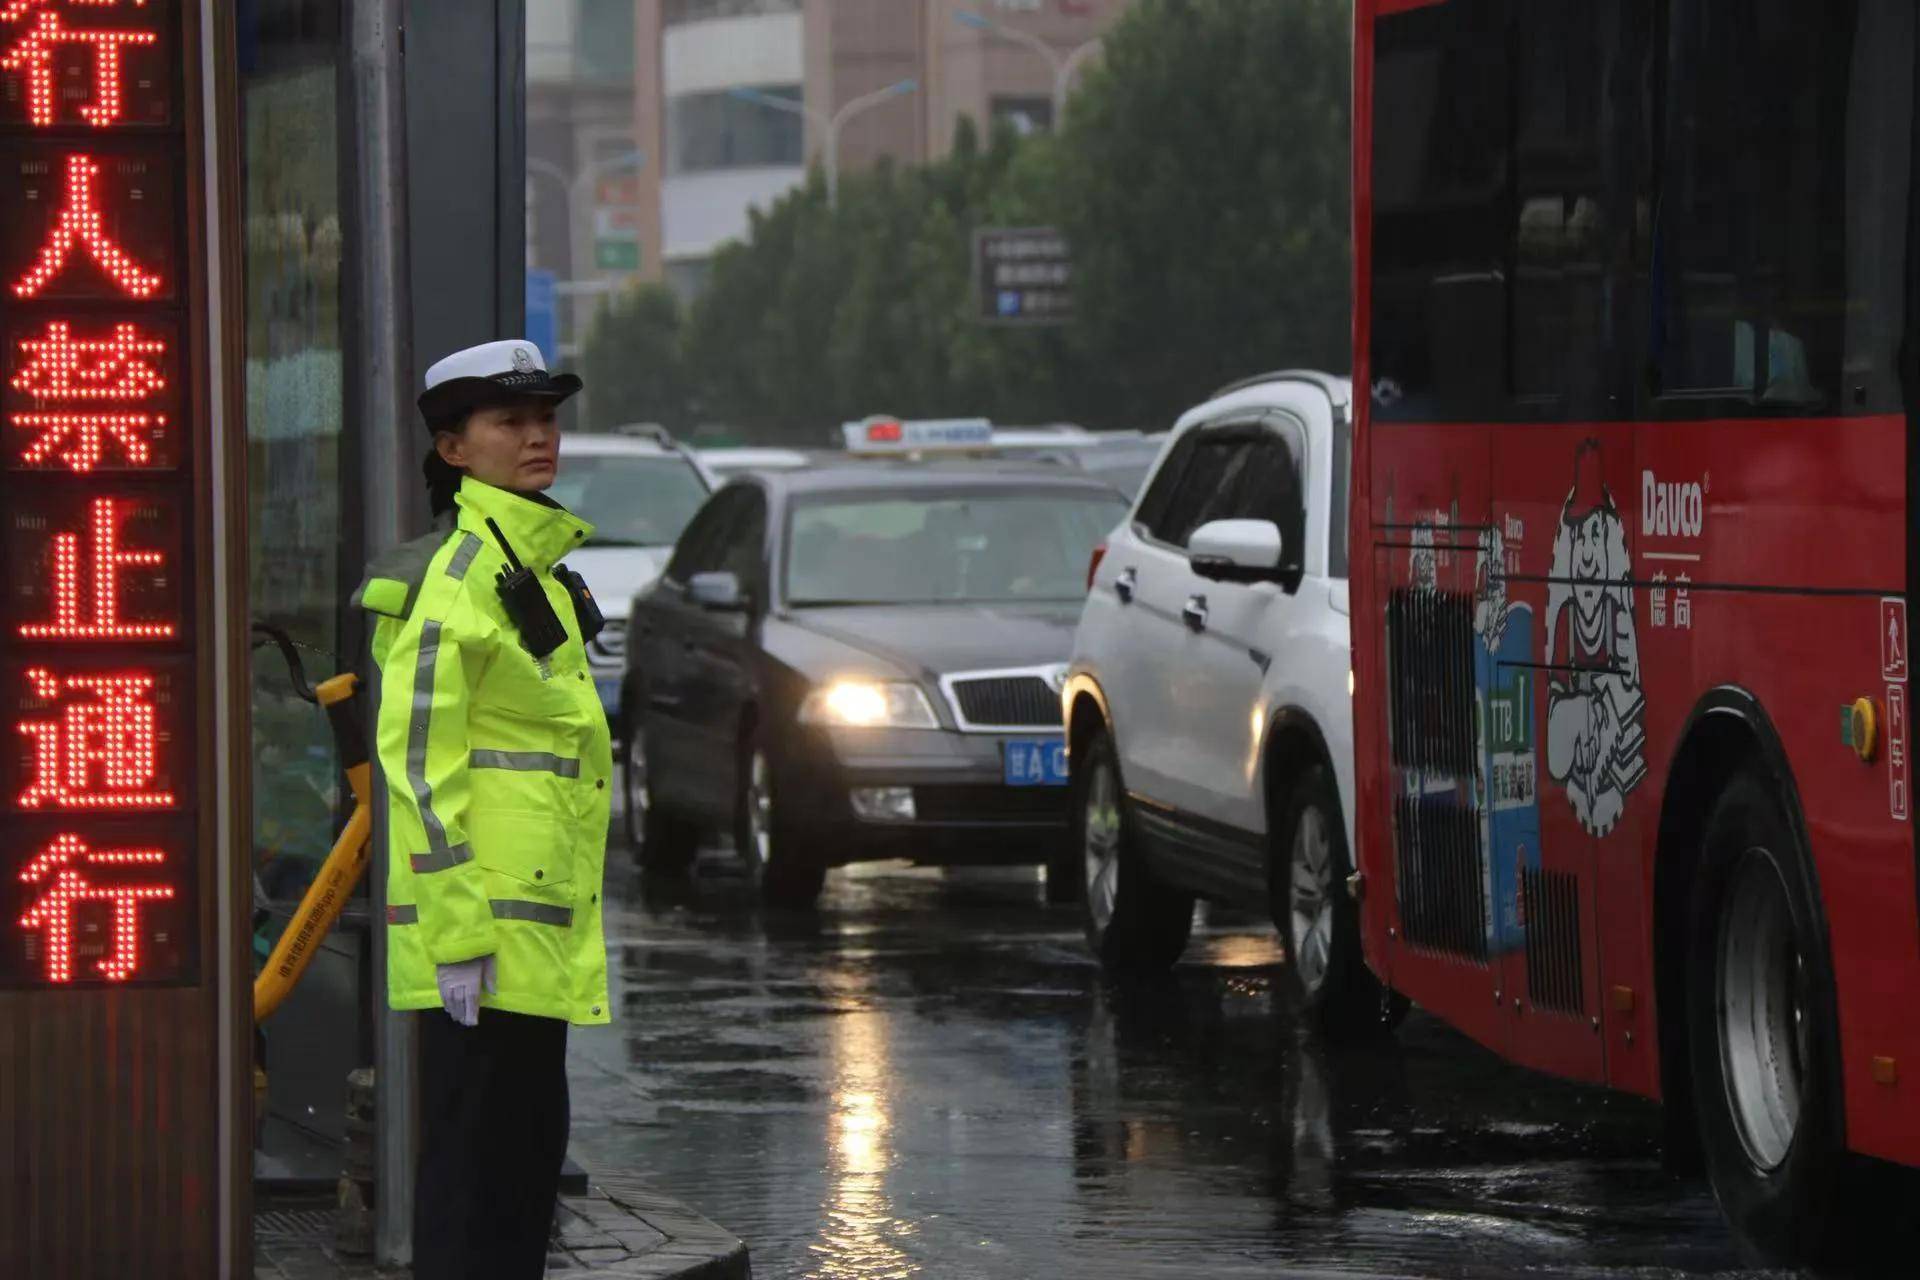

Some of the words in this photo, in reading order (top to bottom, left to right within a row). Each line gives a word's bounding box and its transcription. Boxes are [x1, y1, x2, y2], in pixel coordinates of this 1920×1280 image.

[0, 0, 174, 982] 行人禁止通行
[1643, 469, 1702, 537] Davco
